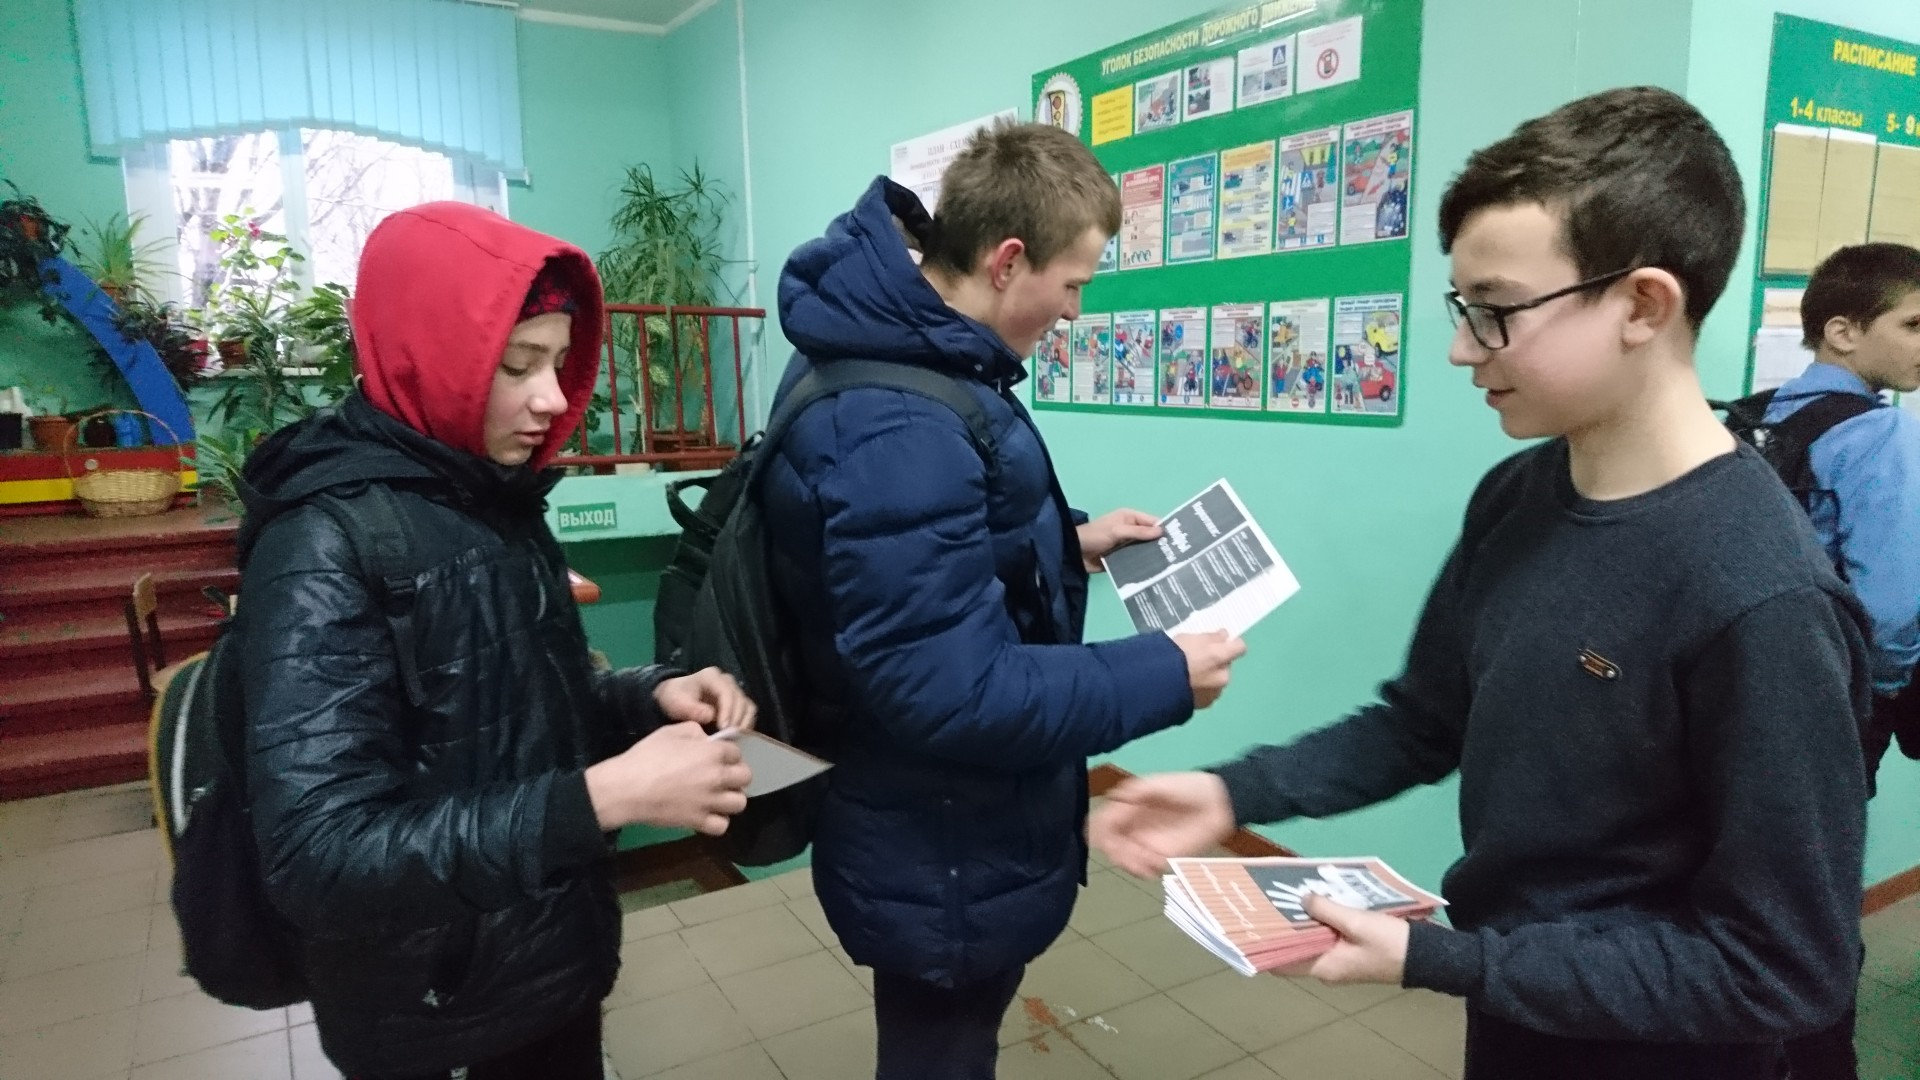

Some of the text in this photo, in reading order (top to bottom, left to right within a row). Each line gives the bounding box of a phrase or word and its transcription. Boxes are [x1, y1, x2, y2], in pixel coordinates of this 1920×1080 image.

[1102, 54, 1132, 76] УГОЛОК
[1133, 30, 1199, 66] БЕЗОПАСНОСТИ
[1201, 9, 1258, 42] ДОРОЖНОГО
[1833, 39, 1917, 76] РАСПИСАНИЕ
[1790, 96, 1864, 128] 1-4 классы
[560, 508, 616, 528] ВЫХОД
